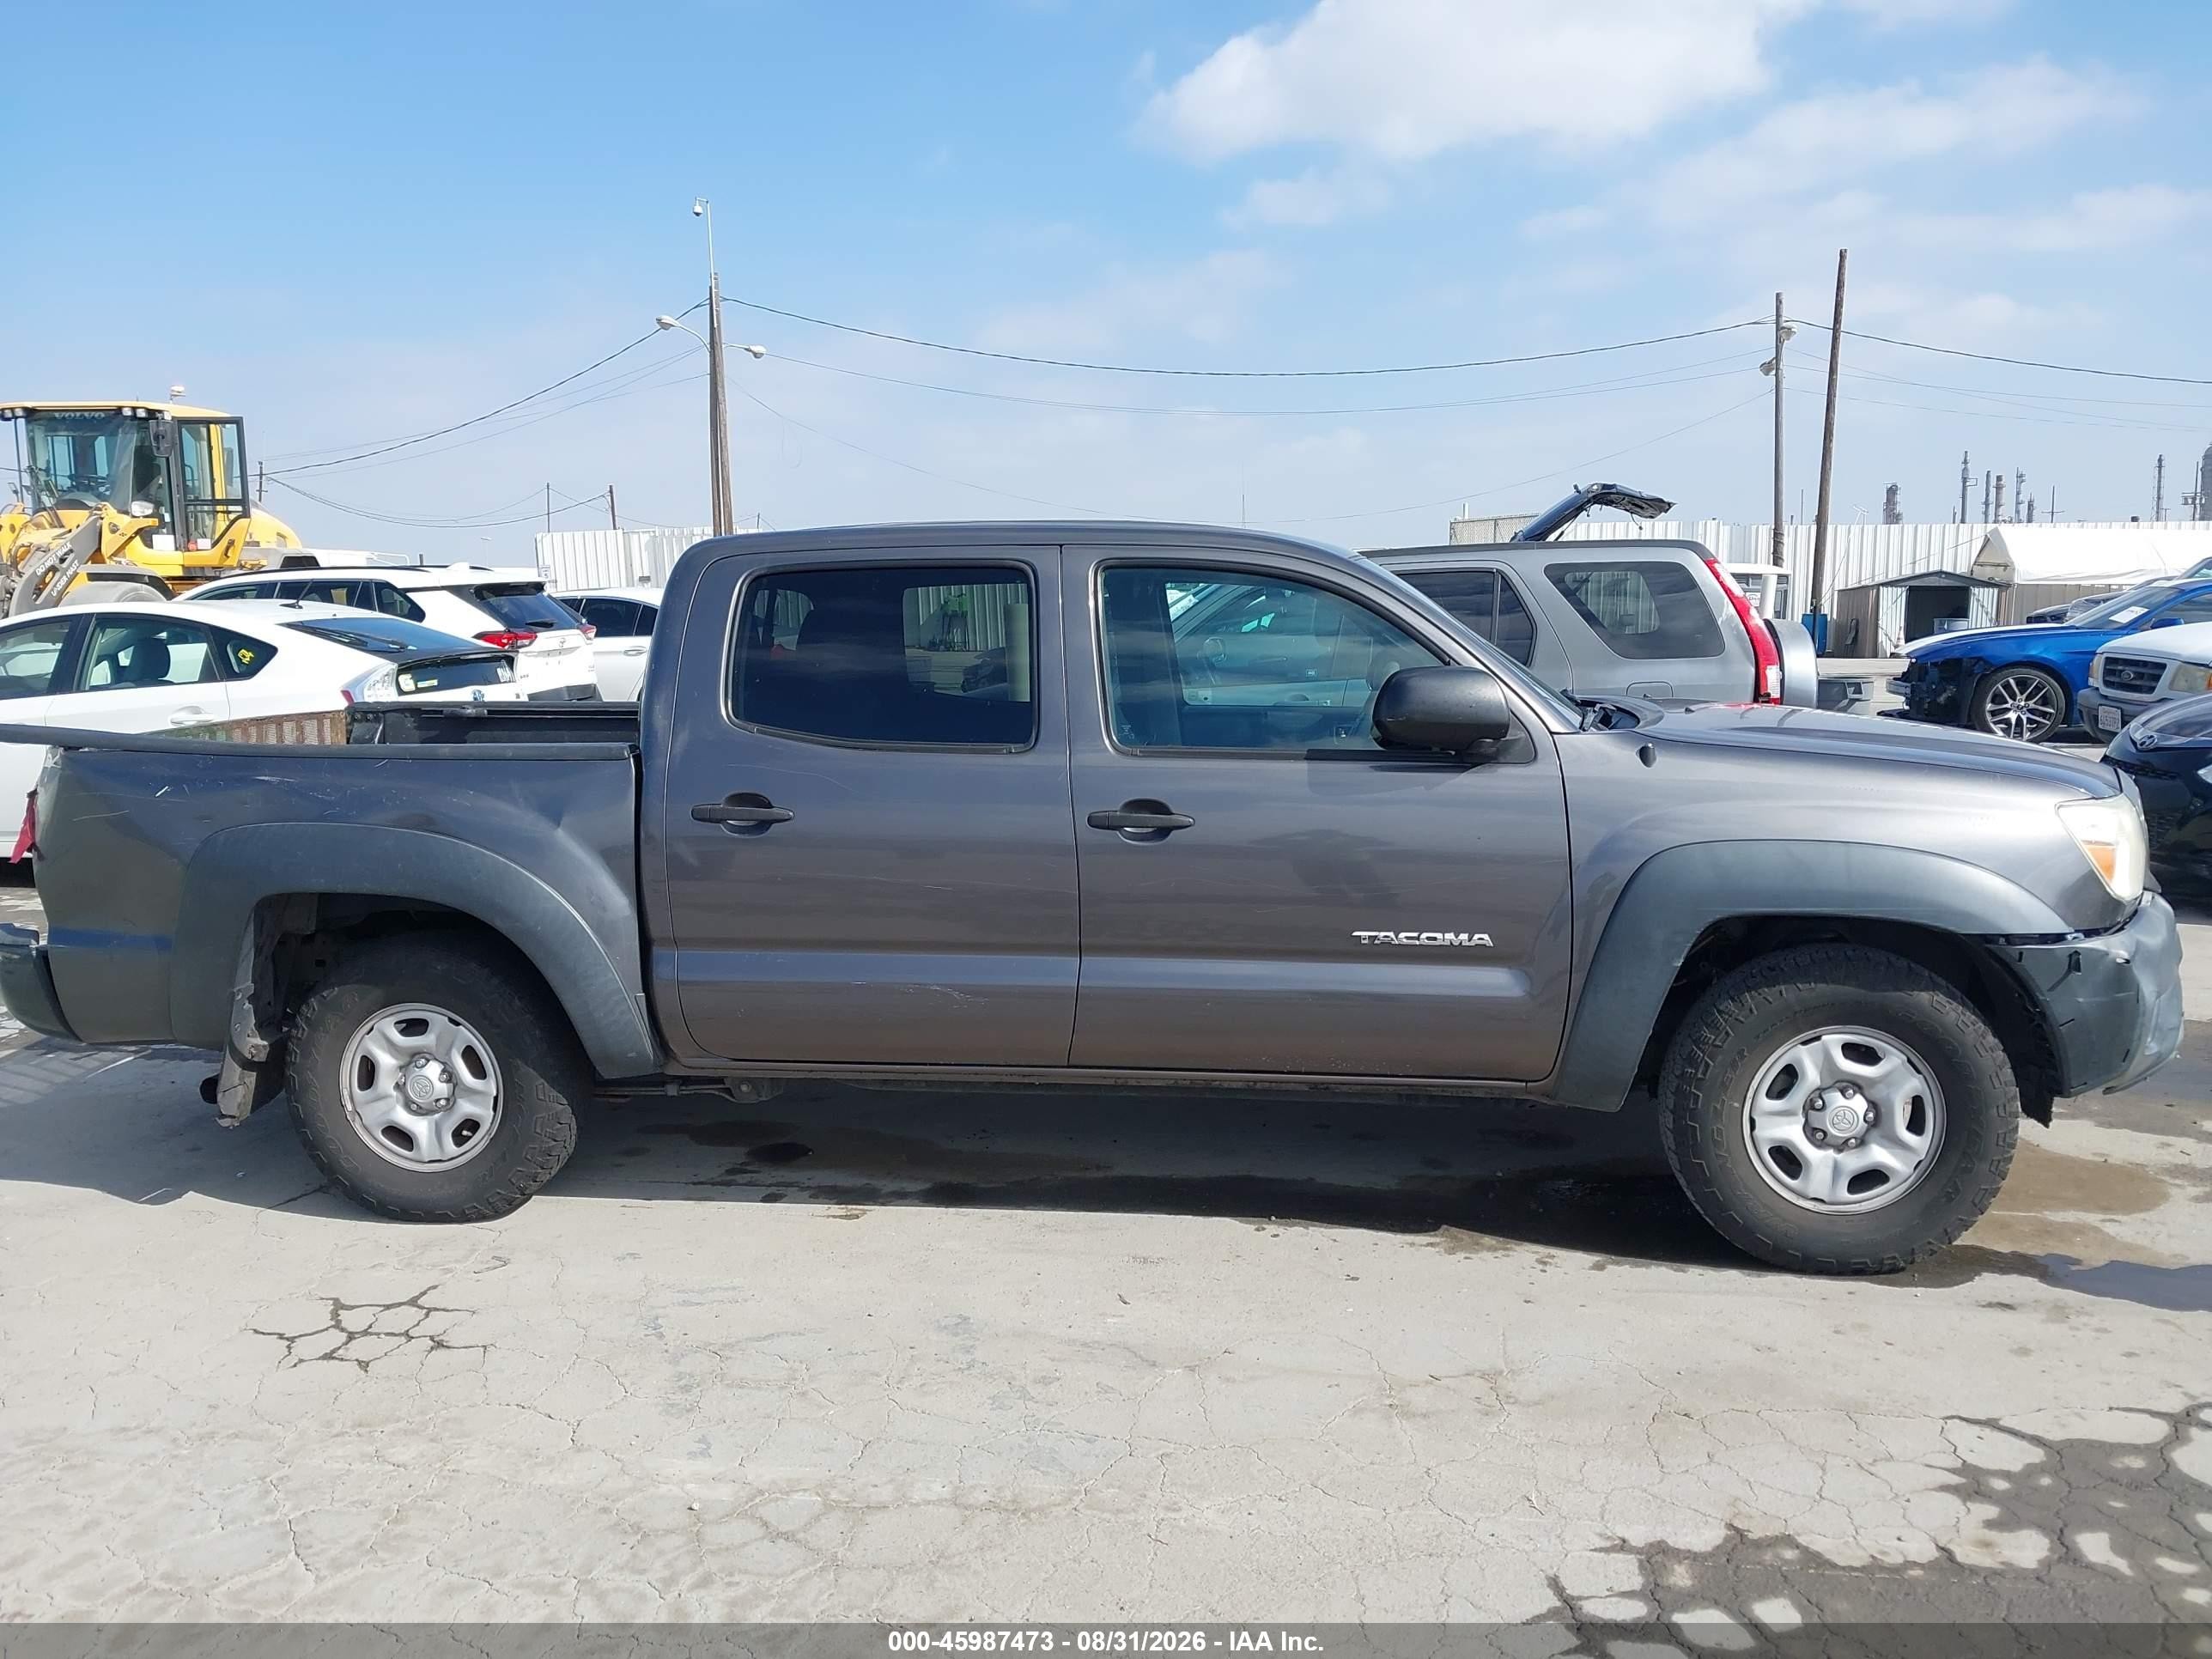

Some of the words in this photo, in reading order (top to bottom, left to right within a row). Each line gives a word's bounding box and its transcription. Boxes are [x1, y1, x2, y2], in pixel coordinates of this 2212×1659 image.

[53, 411, 105, 421] VOLVO
[35, 563, 46, 576] DO
[44, 553, 57, 568] NOT
[56, 540, 72, 557] WALK
[51, 575, 68, 597] UNDER
[66, 559, 79, 579] MAST
[1351, 931, 1494, 947] TACOMA
